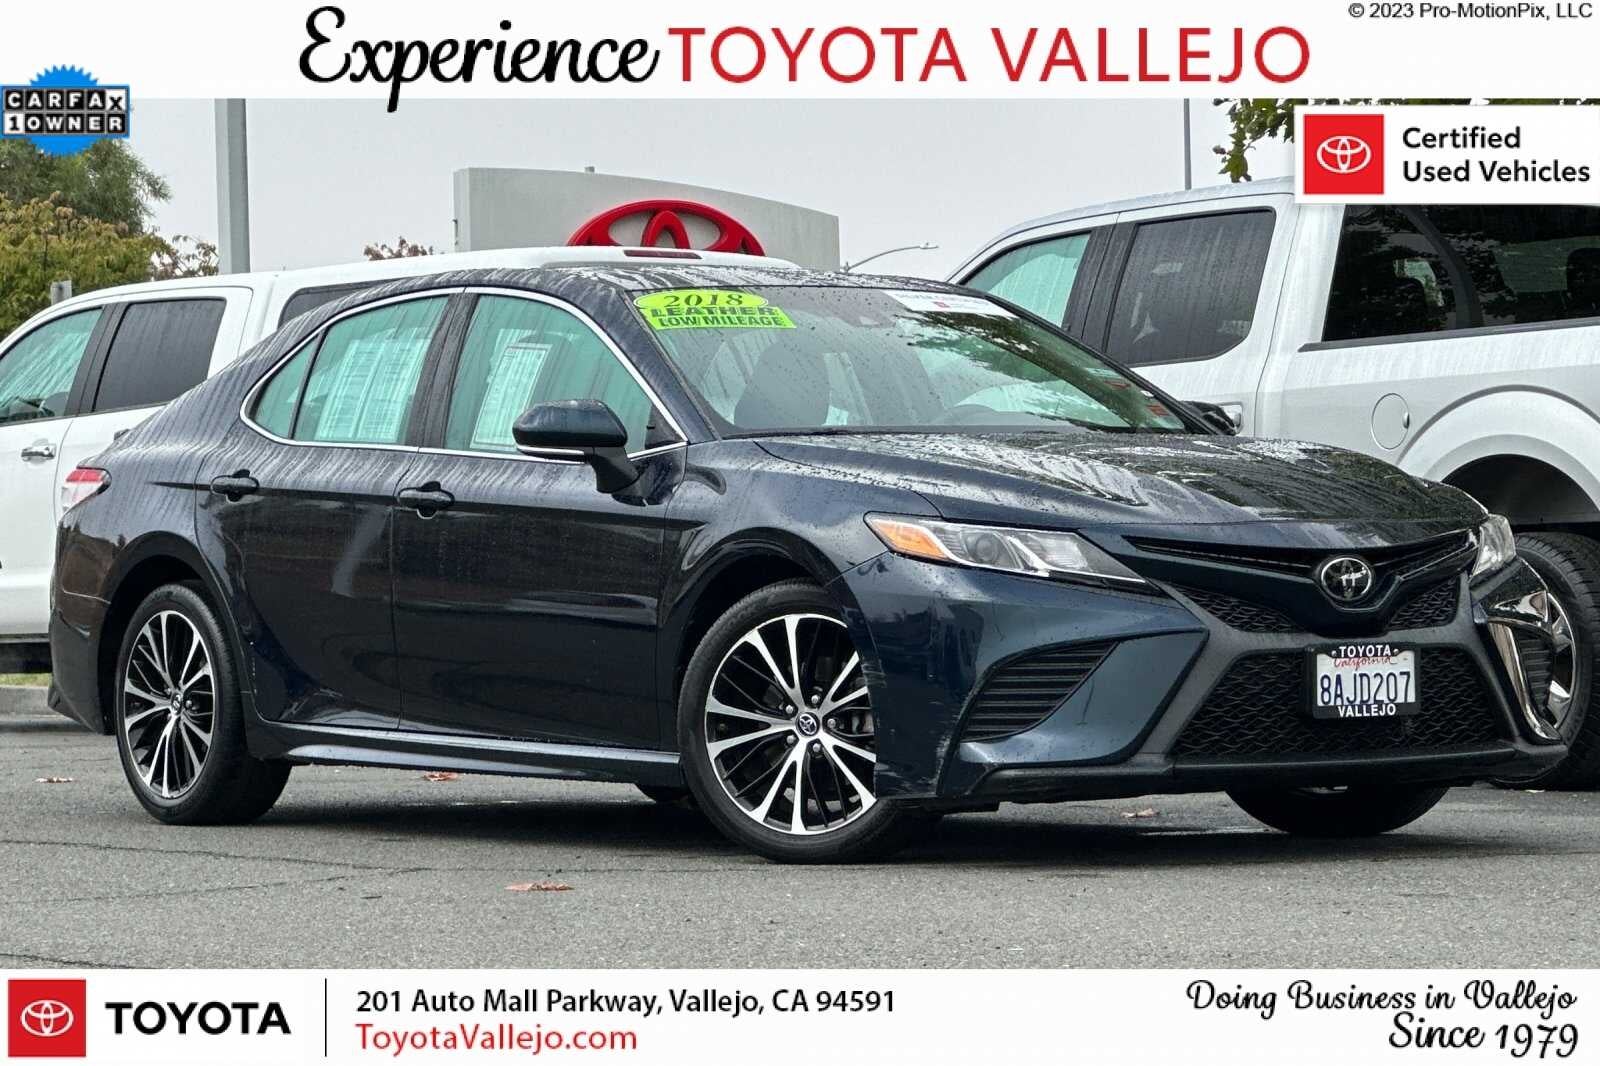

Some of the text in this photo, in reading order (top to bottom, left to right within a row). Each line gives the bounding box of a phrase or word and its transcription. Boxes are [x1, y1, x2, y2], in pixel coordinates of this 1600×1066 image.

[663, 293, 743, 308] 2018
[650, 306, 777, 318] LEATHER
[658, 315, 784, 327] LOW MILEAGE
[1339, 645, 1391, 657] TOYOTA
[1320, 671, 1411, 706] 8AJD207
[1338, 704, 1396, 717] VALLEJO
